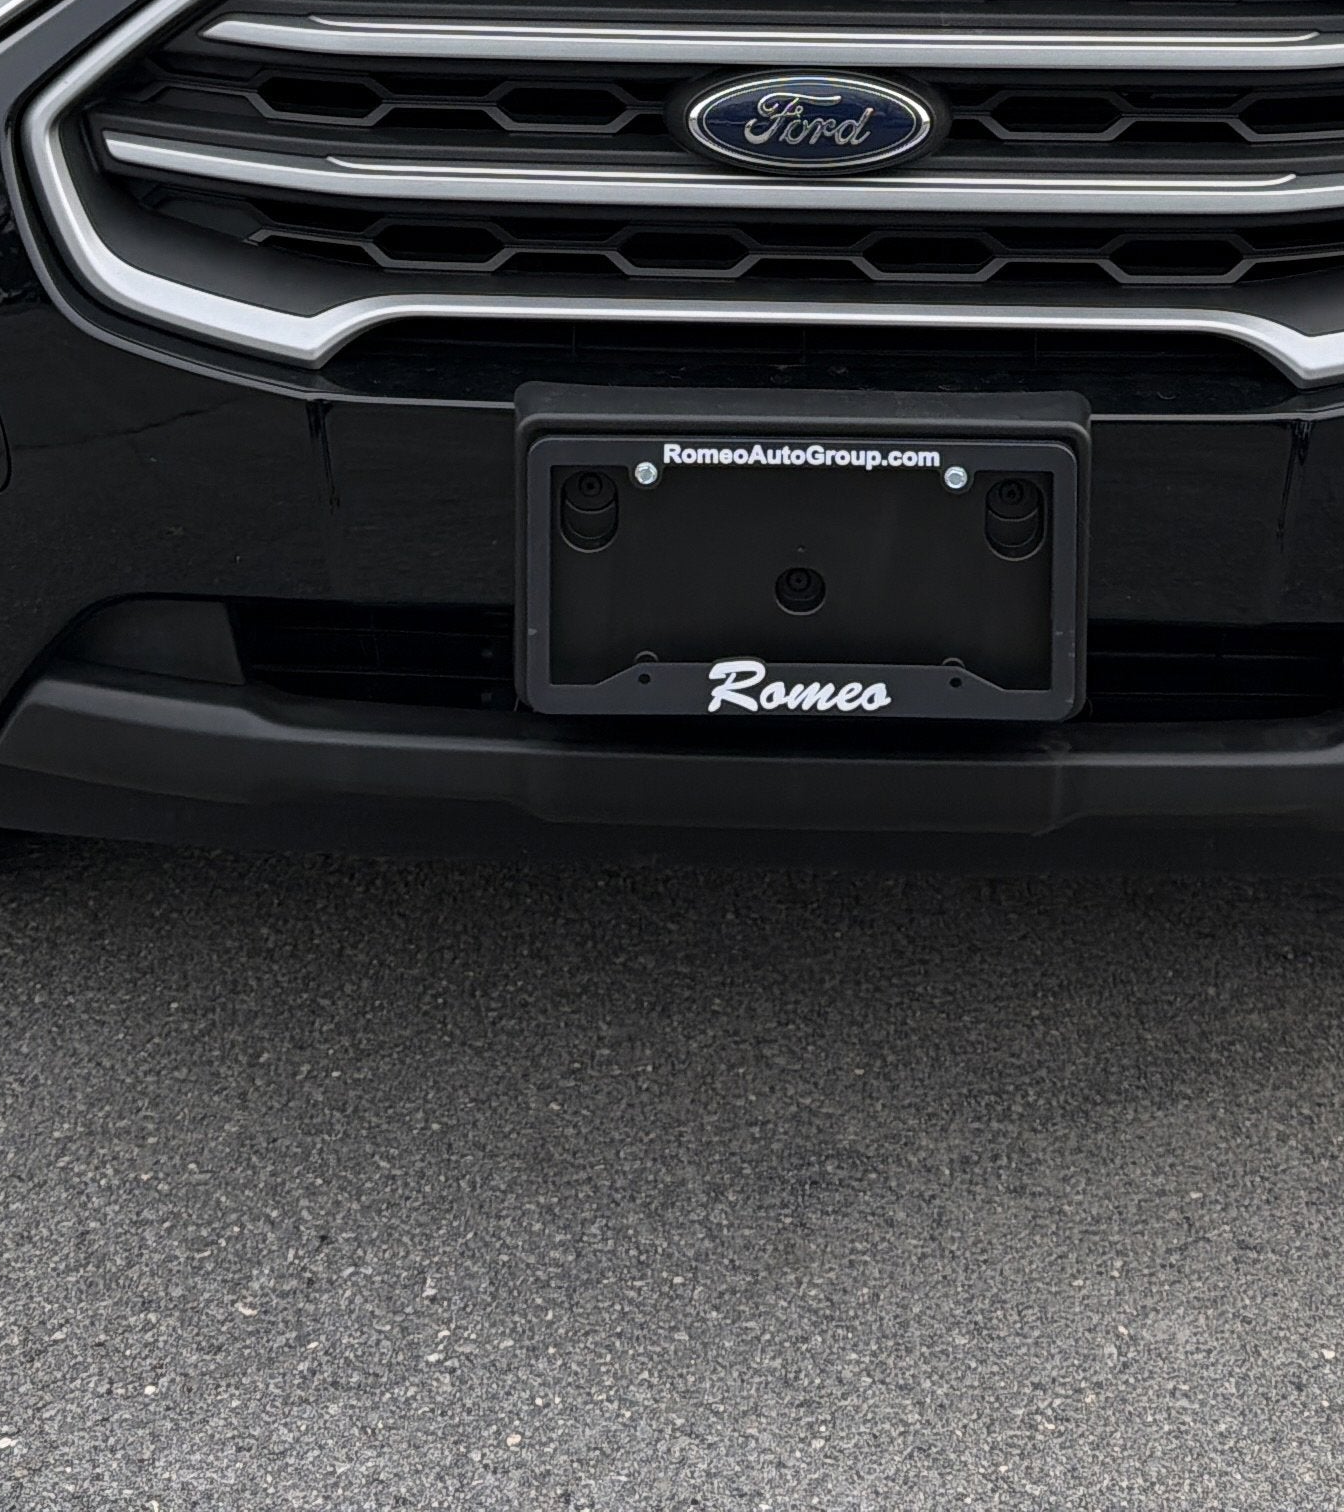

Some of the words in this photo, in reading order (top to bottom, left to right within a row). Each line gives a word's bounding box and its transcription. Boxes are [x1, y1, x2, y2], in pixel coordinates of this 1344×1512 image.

[744, 92, 875, 145] Ford
[663, 443, 941, 470] RomeoAutoGroup.com
[707, 660, 892, 713] Romeo
